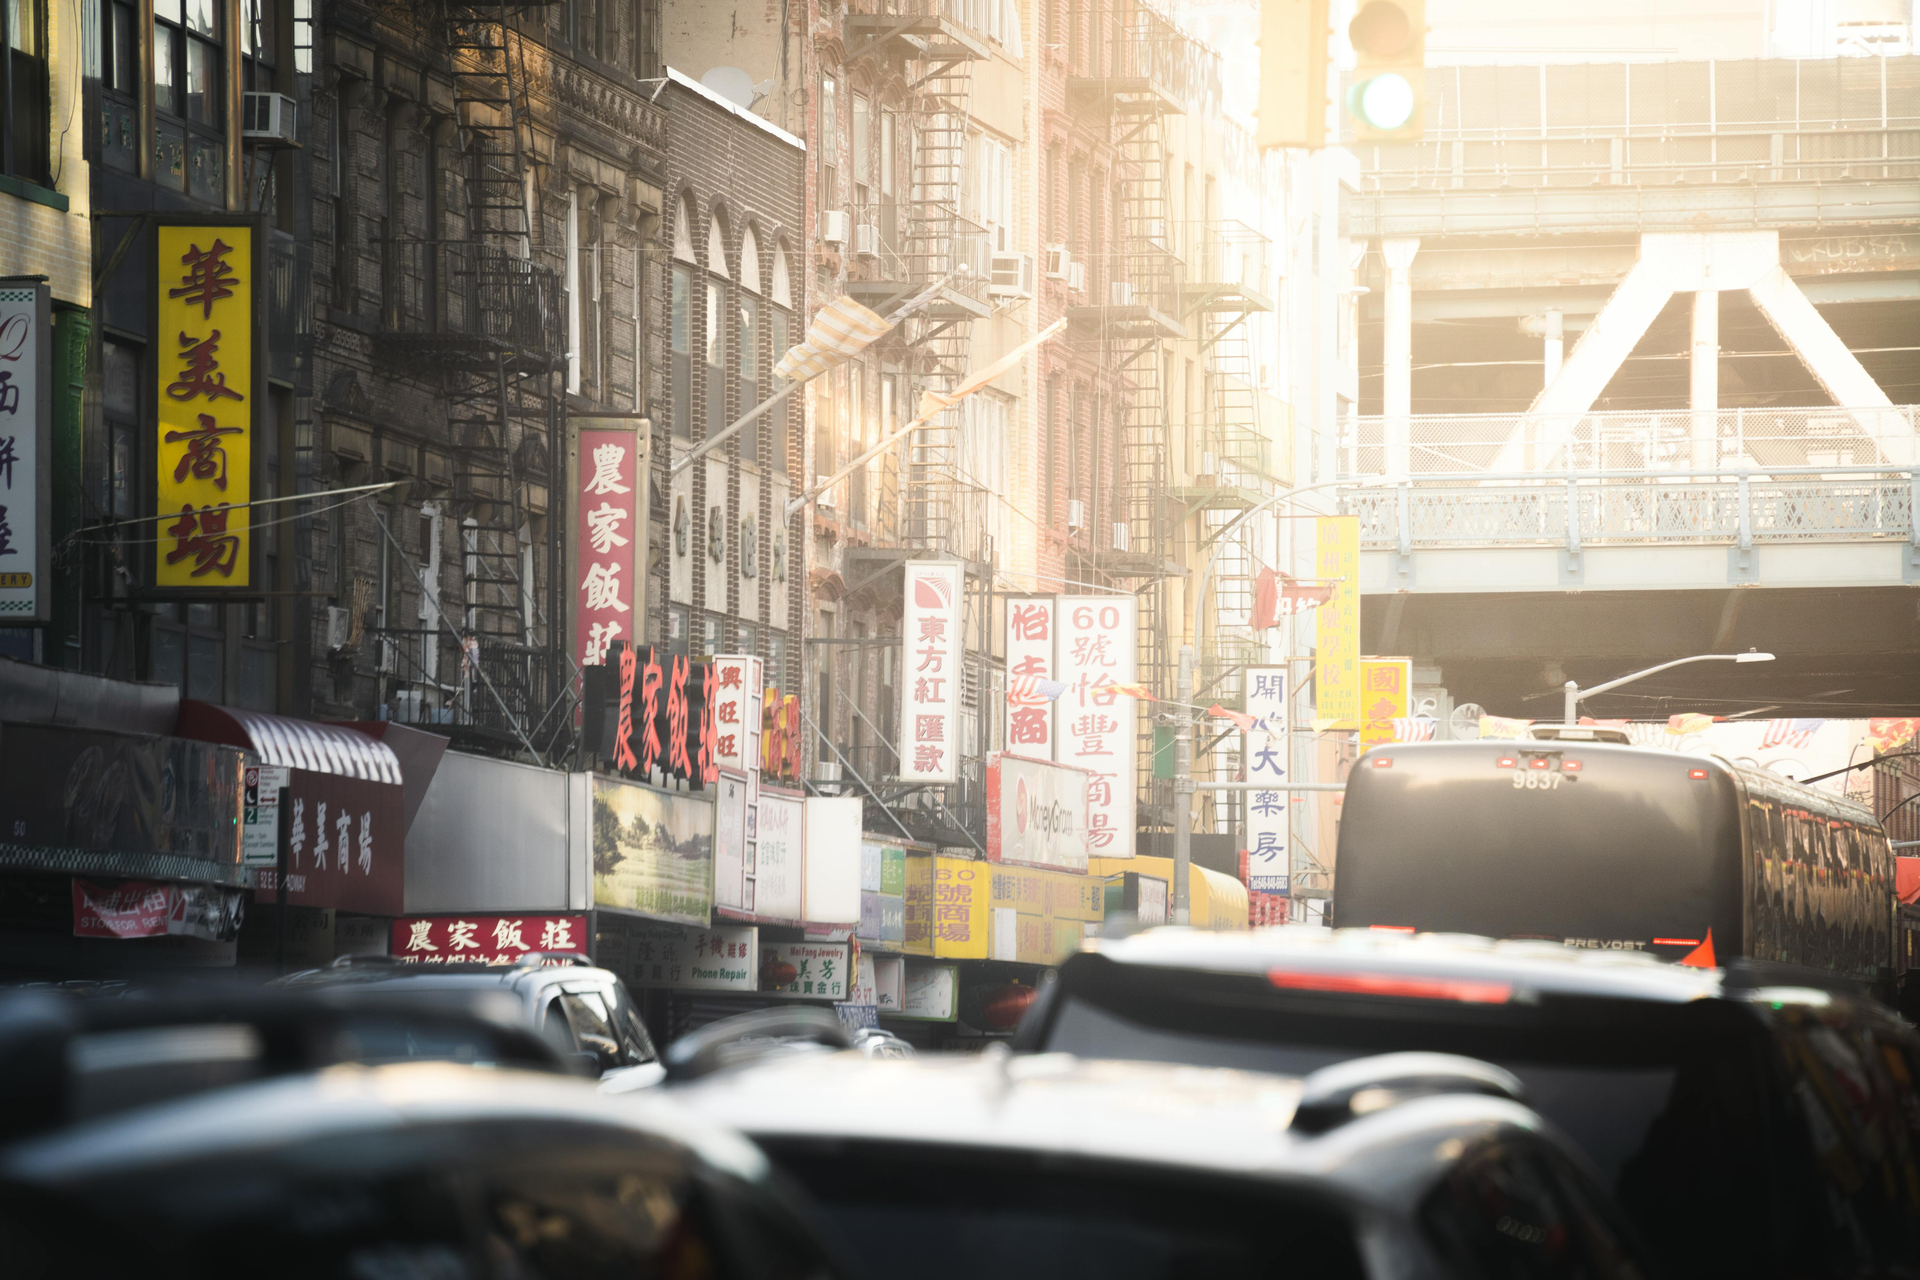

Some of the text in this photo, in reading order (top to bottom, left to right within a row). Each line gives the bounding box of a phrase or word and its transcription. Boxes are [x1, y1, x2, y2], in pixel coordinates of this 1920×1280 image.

[165, 238, 244, 579] 華美商場
[913, 615, 948, 773] 東方紅匯款
[613, 640, 719, 790] 農家飯莊
[717, 666, 743, 759] 興旺旺
[1513, 770, 1562, 790] 9837
[14, 820, 26, 837] 50
[247, 808, 255, 823] 2
[1029, 795, 1073, 843] MoneyGram
[290, 797, 373, 877] 華美商場
[141, 914, 169, 929] RENT
[405, 919, 577, 952] 農家飯莊
[1564, 937, 1646, 951] PREVOST
[790, 946, 801, 957] Mei
[801, 947, 817, 960] Fang
[818, 947, 843, 961] Jewelry
[691, 966, 748, 983] Phone Repair
